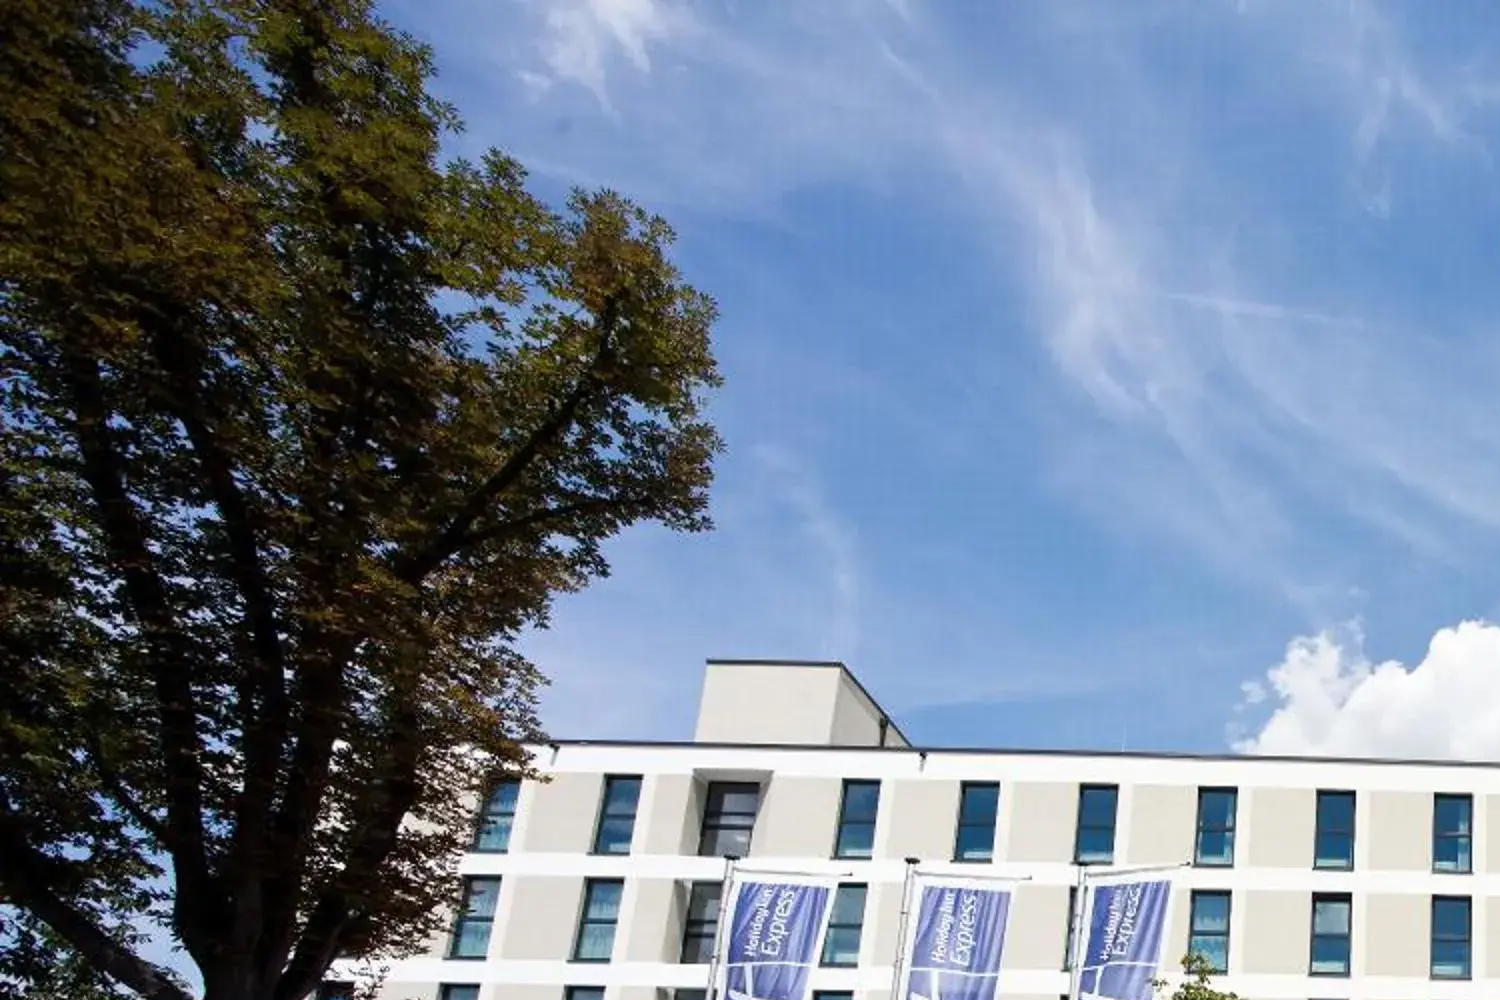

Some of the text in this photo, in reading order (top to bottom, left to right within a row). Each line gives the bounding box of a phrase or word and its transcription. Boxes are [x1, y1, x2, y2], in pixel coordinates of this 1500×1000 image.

[743, 907, 770, 958] Holiday
[761, 889, 796, 956] Express
[950, 893, 977, 967] Express
[1099, 908, 1123, 962] Holiday
[1113, 885, 1142, 956] Express
